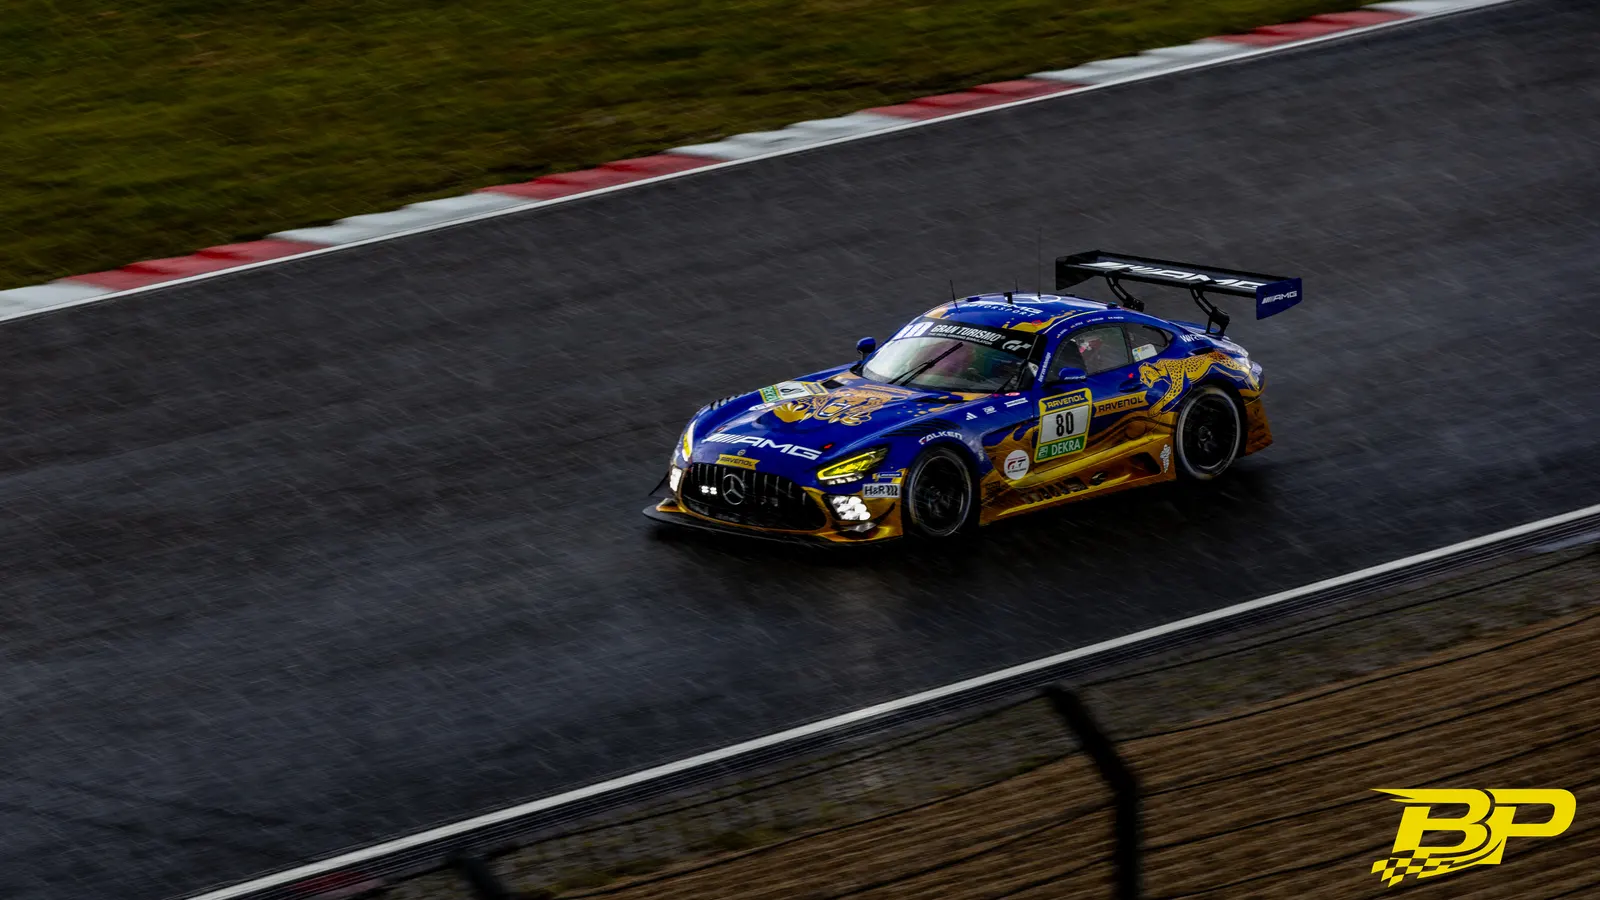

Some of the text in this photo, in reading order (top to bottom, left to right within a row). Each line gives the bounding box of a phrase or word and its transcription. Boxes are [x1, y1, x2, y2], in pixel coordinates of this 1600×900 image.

[930, 324, 960, 334] GRAN
[1046, 394, 1085, 409] RAVENOL
[1098, 396, 1144, 413] RAVENOL
[1056, 411, 1074, 437] 80
[918, 430, 963, 445] FALKEN
[1051, 438, 1081, 456] DEKRA
[864, 485, 885, 496] H&R
